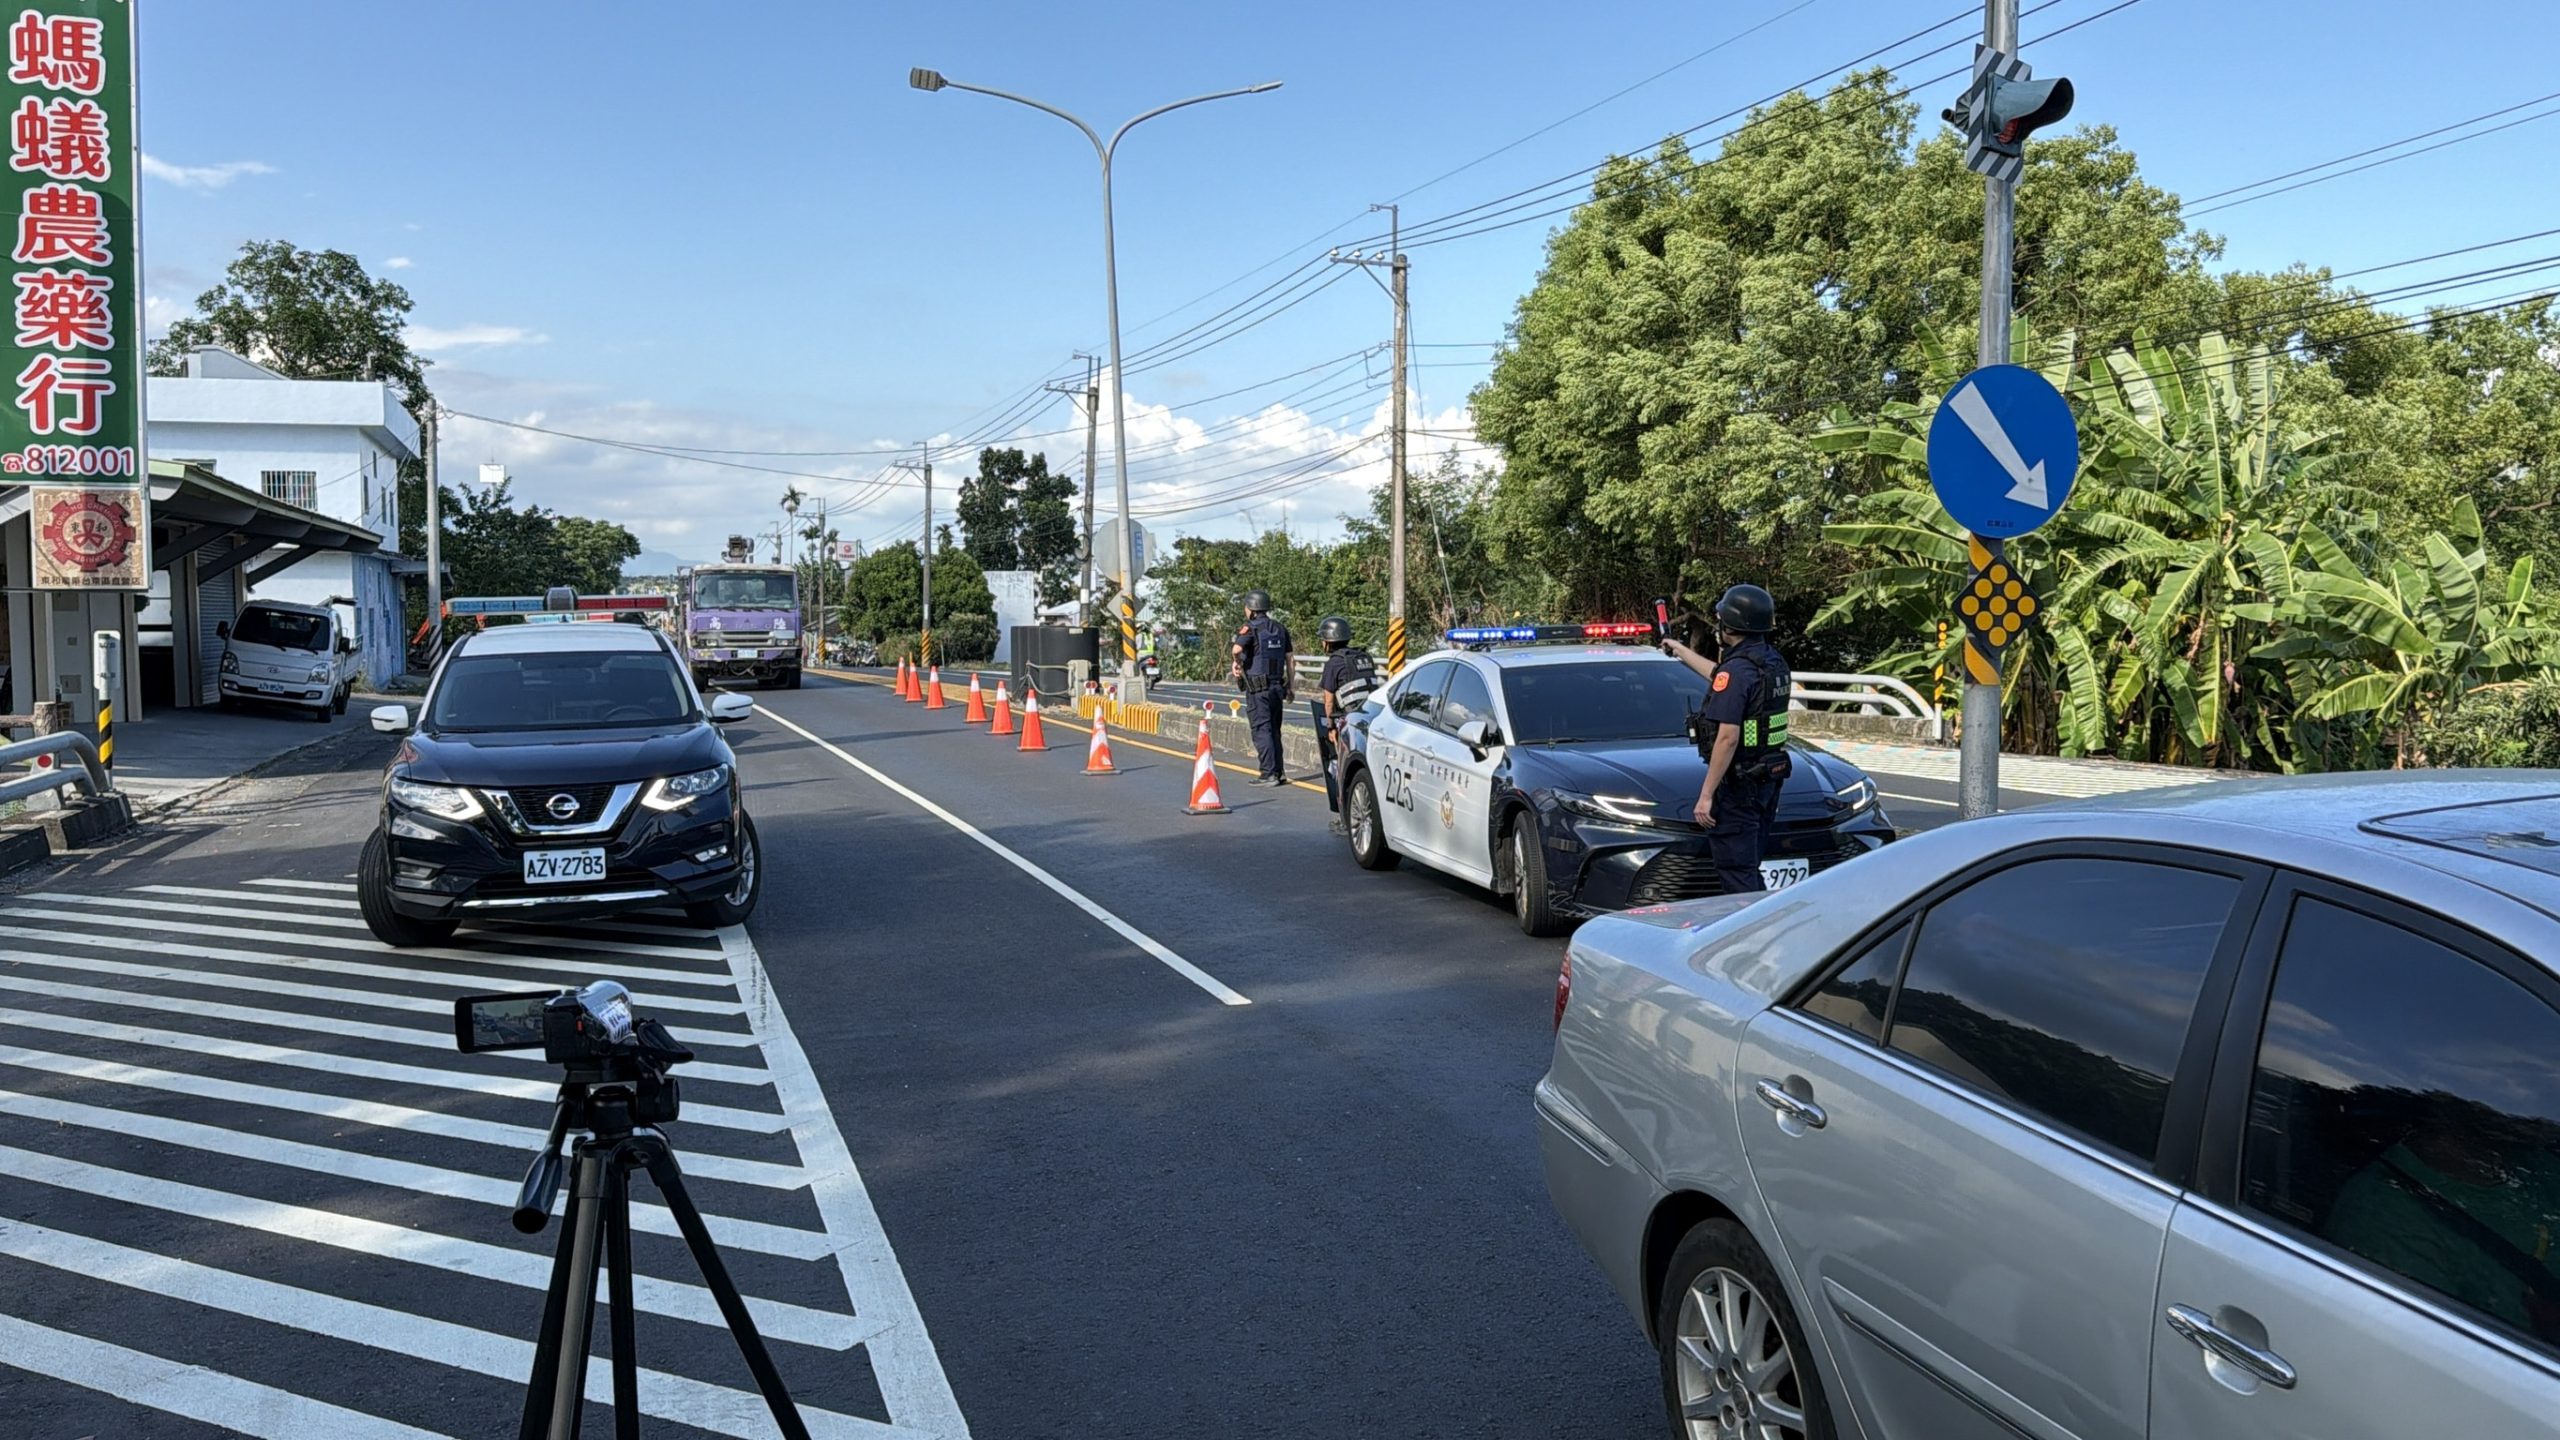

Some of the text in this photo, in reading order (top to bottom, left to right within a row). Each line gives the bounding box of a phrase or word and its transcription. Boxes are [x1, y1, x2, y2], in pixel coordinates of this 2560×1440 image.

[10, 10, 115, 436] 螞蟻農藥行
[24, 444, 134, 476] 812001
[1383, 763, 1415, 813] 225
[527, 856, 603, 878] AZV-2783
[1760, 866, 1808, 889] -9792
